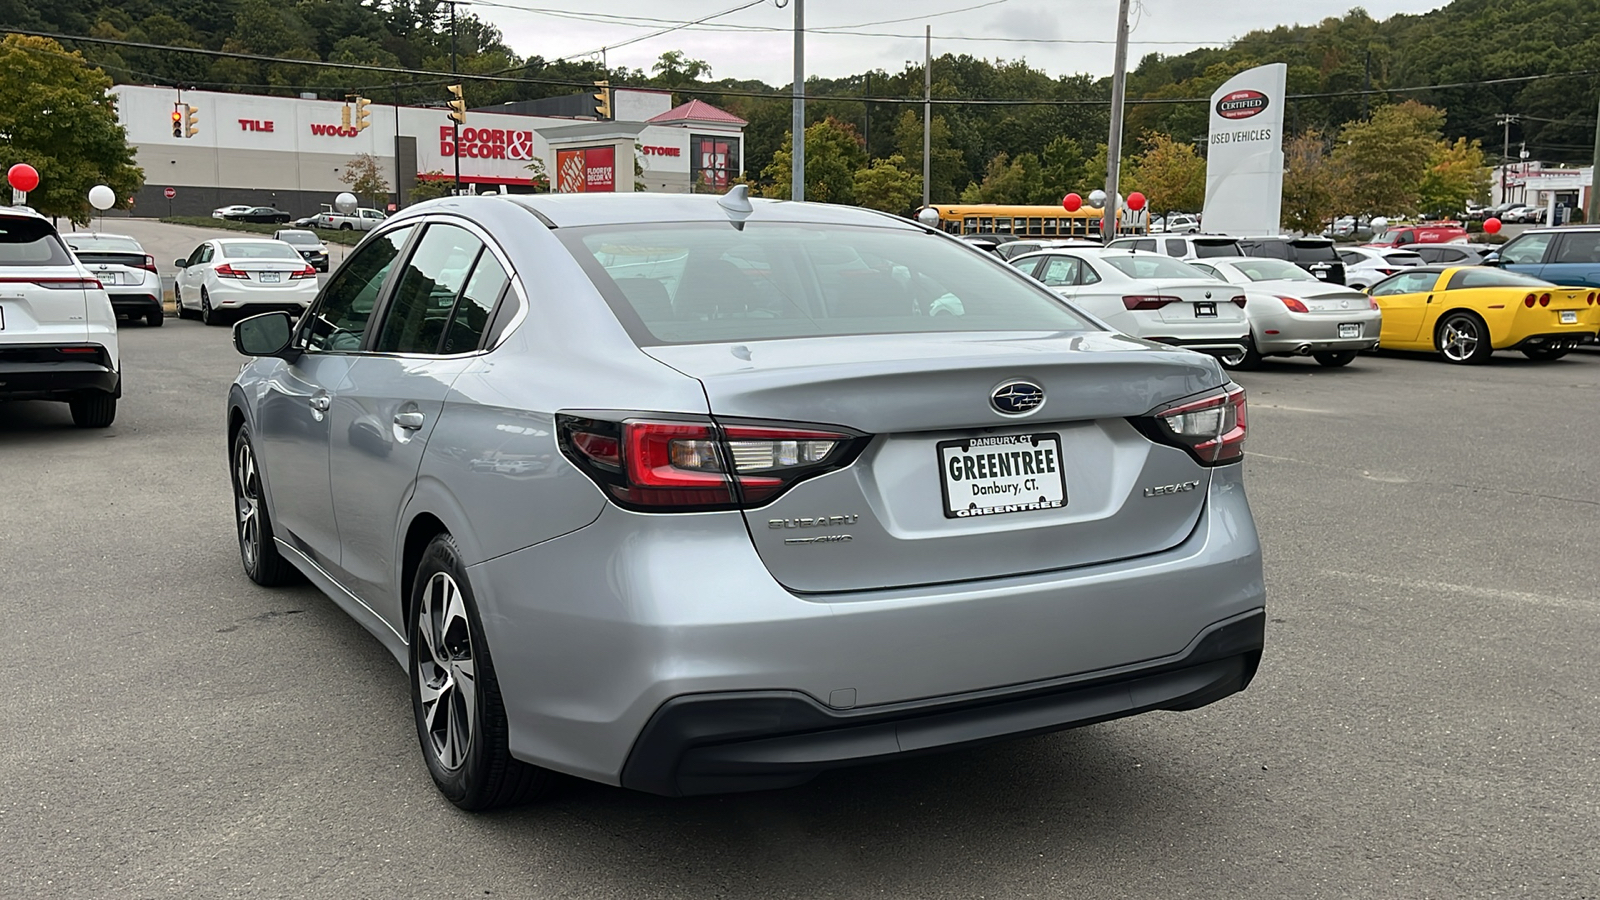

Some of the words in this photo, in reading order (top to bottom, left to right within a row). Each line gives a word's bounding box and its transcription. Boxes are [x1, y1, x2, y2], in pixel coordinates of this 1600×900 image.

[1221, 99, 1262, 111] CERTIFIED
[238, 119, 274, 132] TILE
[310, 123, 359, 138] WOOD
[439, 125, 506, 144] FLOOR
[1211, 132, 1230, 145] USED
[1232, 129, 1271, 142] VEHICLES
[440, 141, 506, 160] DECOR
[642, 145, 680, 157] STONE
[970, 436, 1018, 447] DANBURY,
[1019, 435, 1032, 444] CT
[949, 449, 1055, 481] GREENTREE
[972, 481, 1022, 496] Danbury,
[1024, 478, 1039, 491] CT.
[1143, 479, 1200, 498] LEGACY
[956, 500, 1062, 517] GREENTREE
[768, 514, 858, 529] SUBARU
